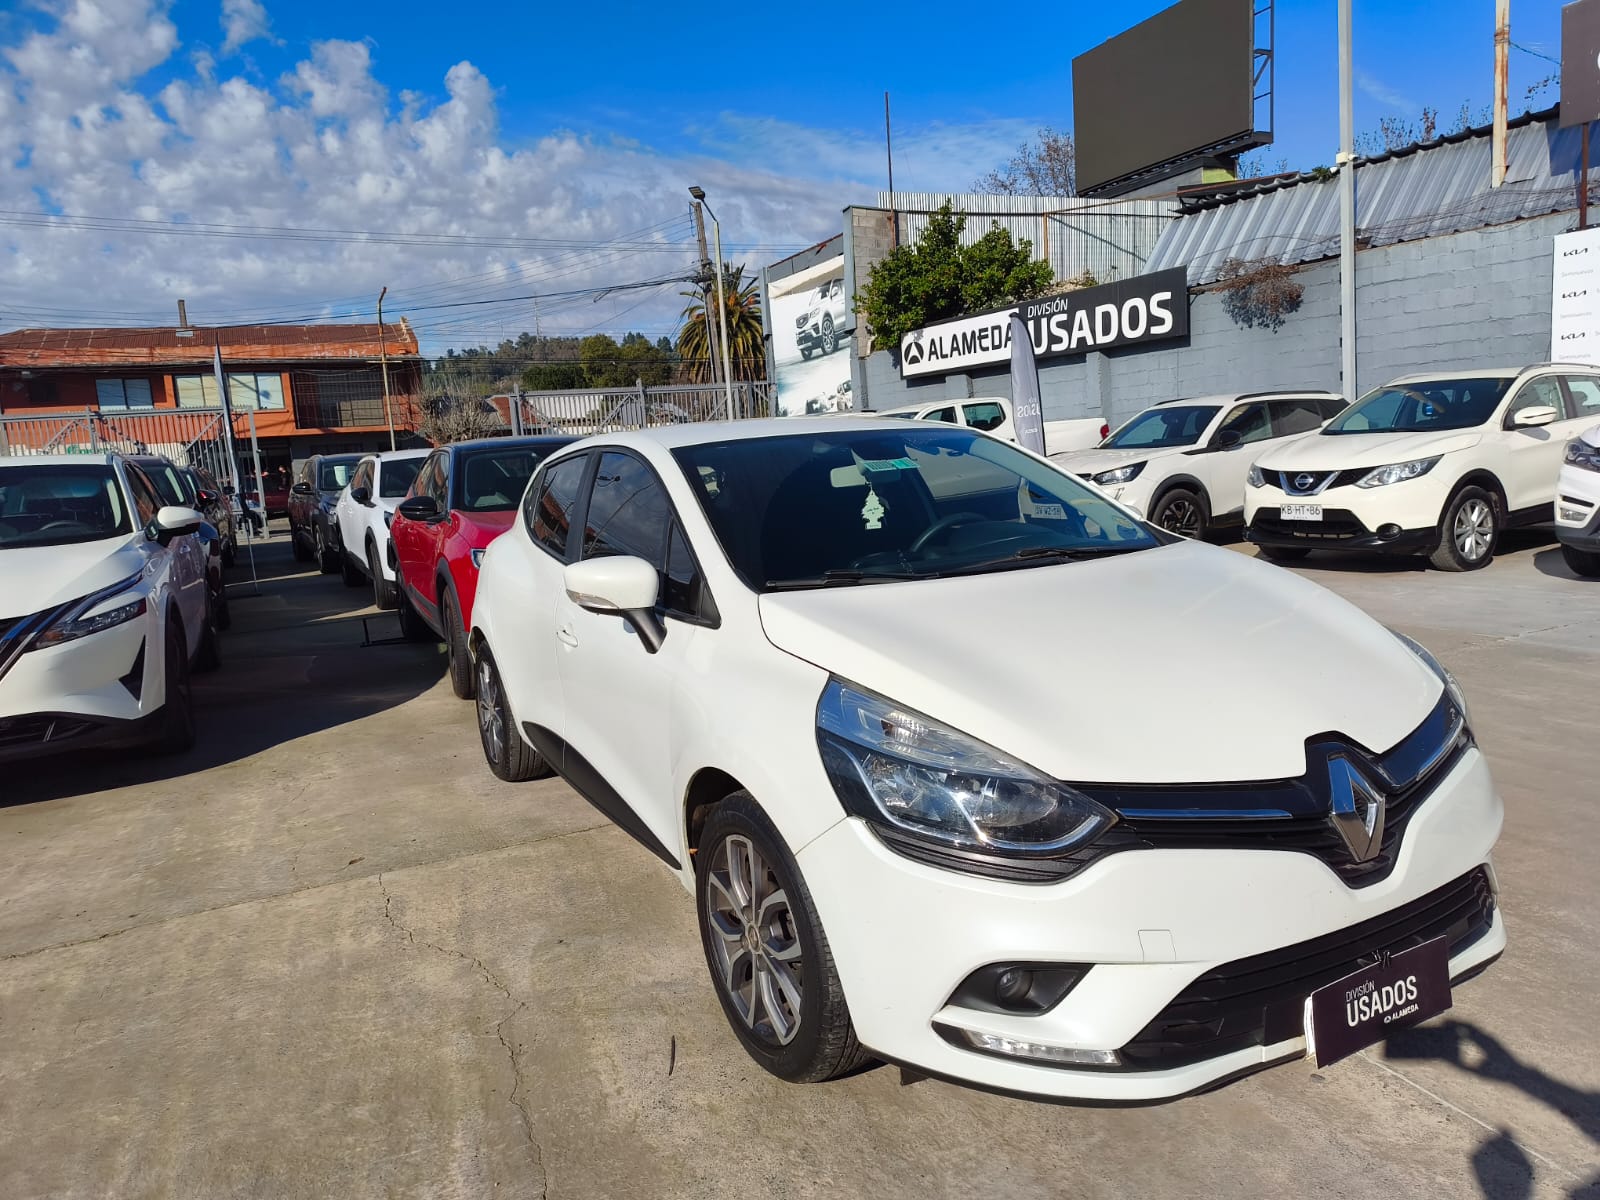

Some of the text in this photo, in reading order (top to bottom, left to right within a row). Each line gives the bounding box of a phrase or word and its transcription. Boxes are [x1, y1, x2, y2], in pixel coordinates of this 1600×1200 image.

[1027, 297, 1069, 318] DIVISIÓN
[1027, 291, 1174, 355] USADOS
[1345, 980, 1375, 1002] DIVISIÓN
[1346, 975, 1418, 1027] USADOS
[1392, 1003, 1420, 1020] ALAMEDA
